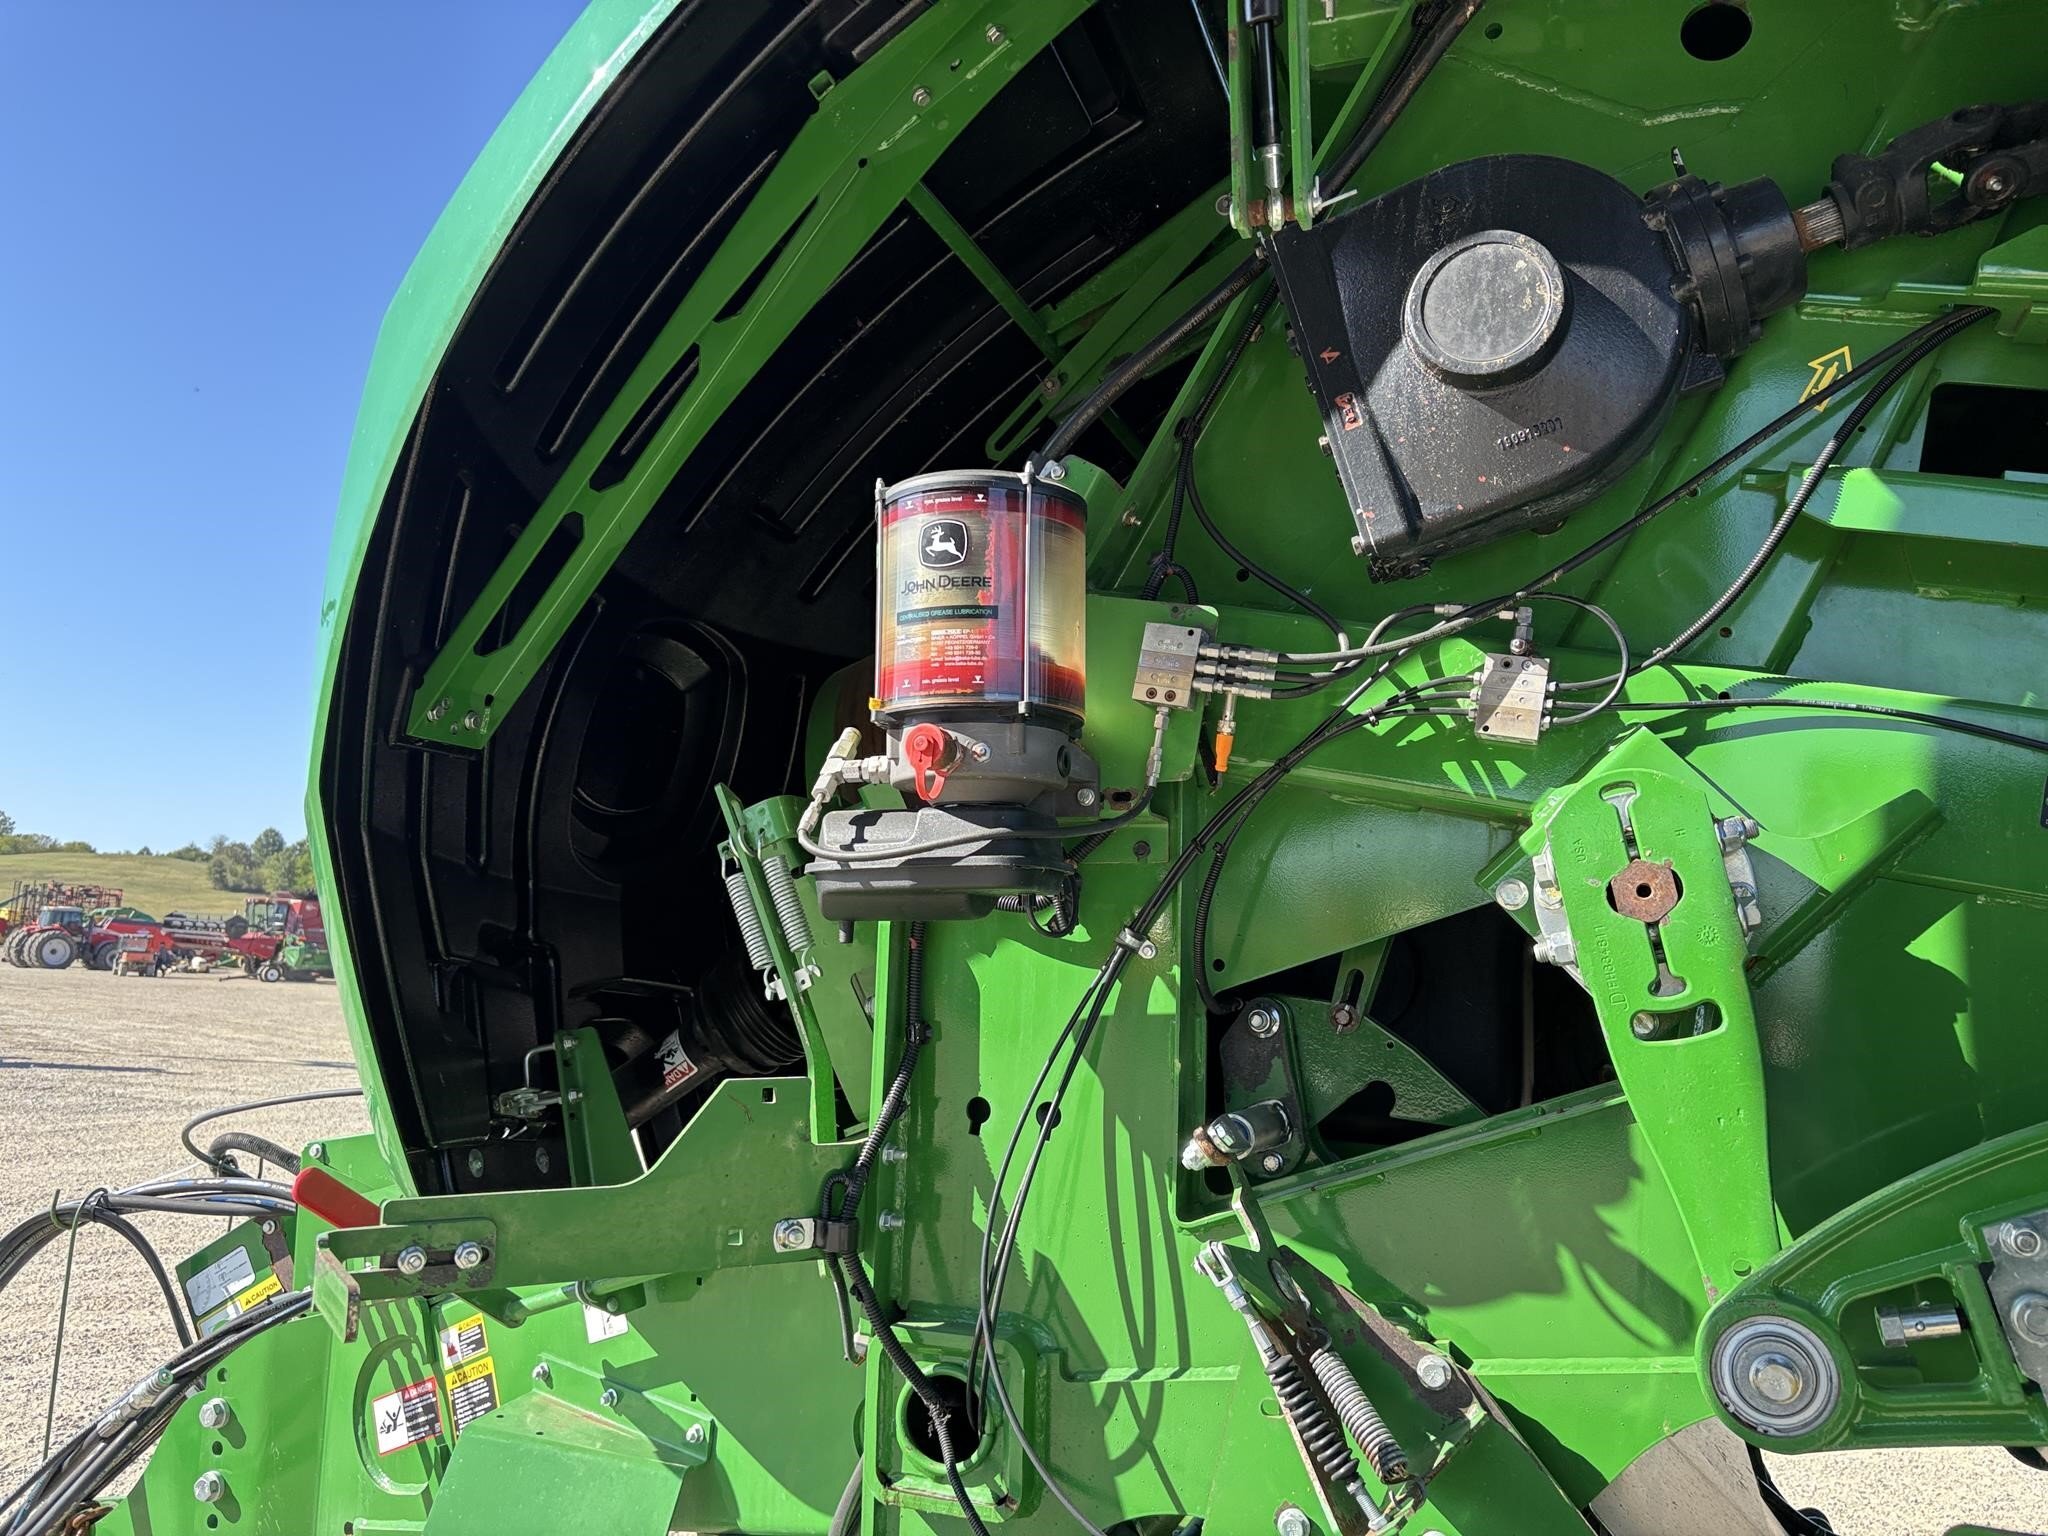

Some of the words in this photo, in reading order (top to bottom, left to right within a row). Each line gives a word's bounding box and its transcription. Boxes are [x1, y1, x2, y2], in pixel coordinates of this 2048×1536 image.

[901, 578, 936, 595] JOHN
[938, 575, 992, 588] DEERE
[931, 609, 953, 617] GREASE
[954, 608, 993, 616] LUBRICATION
[251, 1281, 278, 1302] CAUTION
[457, 1362, 489, 1383] CAUTION
